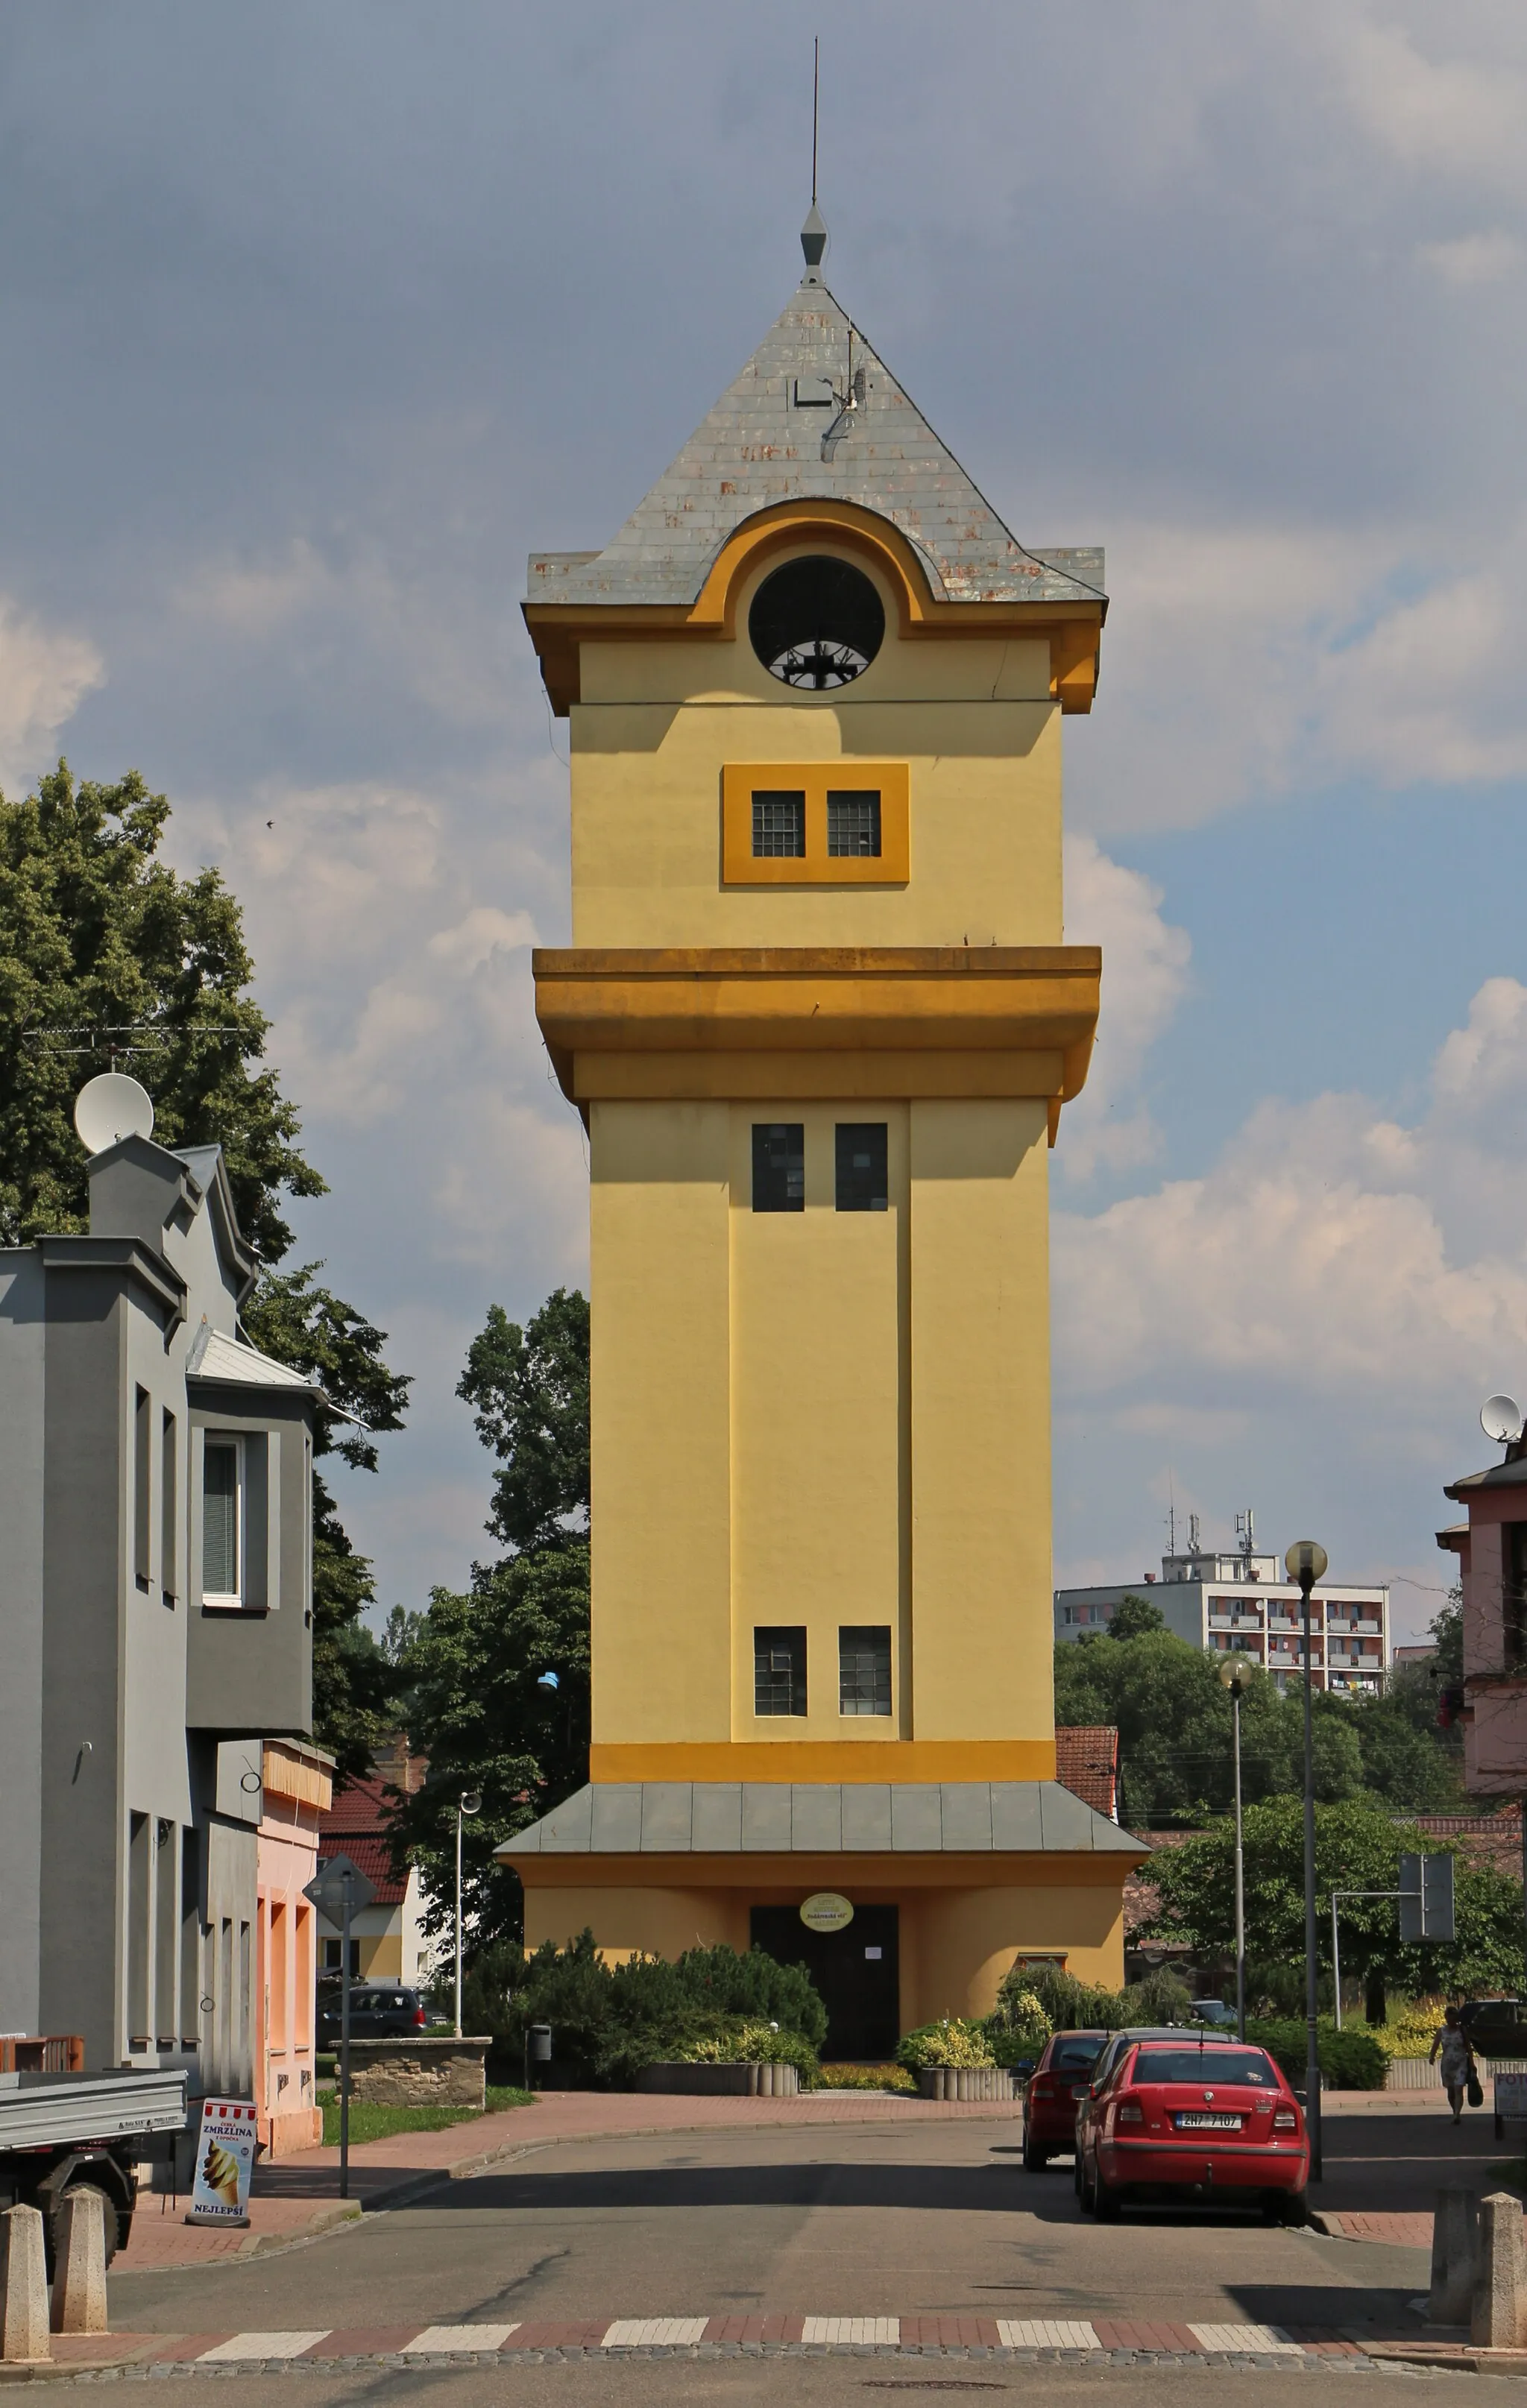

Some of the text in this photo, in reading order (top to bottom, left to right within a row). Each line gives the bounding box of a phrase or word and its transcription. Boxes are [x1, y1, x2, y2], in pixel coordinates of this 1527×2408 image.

[1497, 2074, 1527, 2086] FOT
[1185, 2114, 1203, 2125] 2H7
[1211, 2115, 1236, 2126] 7107
[204, 2125, 252, 2137] ZMRZLINA
[195, 2204, 243, 2216] NEJLEPŠÍ
